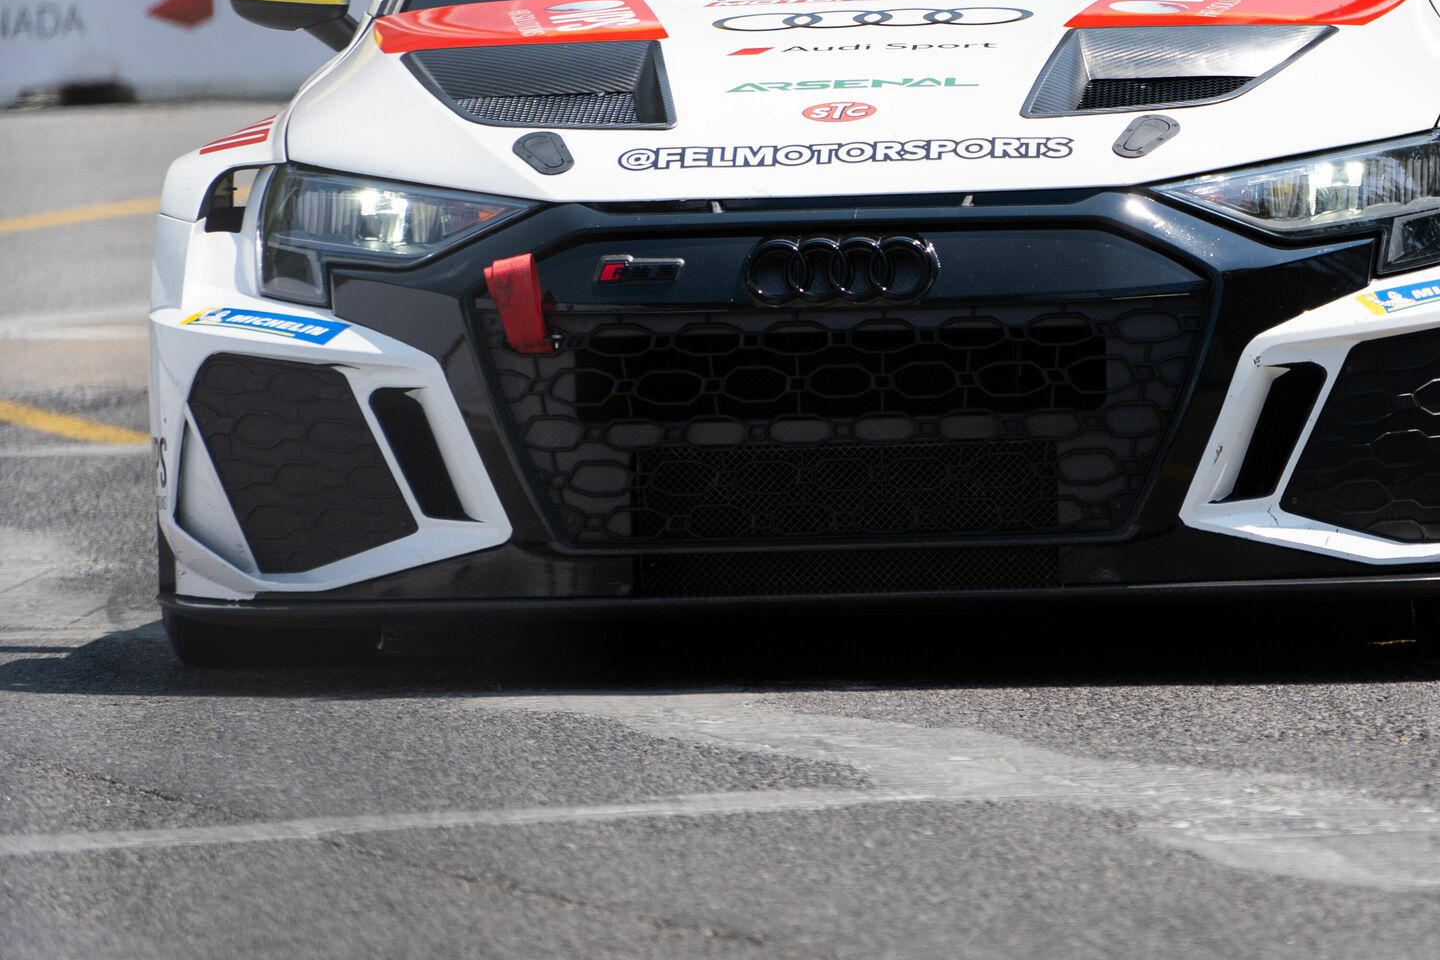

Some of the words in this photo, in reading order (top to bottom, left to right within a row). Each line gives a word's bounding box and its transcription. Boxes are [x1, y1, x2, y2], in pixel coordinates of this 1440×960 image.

[549, 7, 640, 31] VPS
[781, 42, 871, 53] Audi
[885, 42, 998, 51] Sport
[725, 77, 980, 93] ARSENAL
[809, 102, 870, 120] STC
[617, 137, 1076, 171] @FELMOTORSPORTS
[225, 314, 330, 337] MICHELIN
